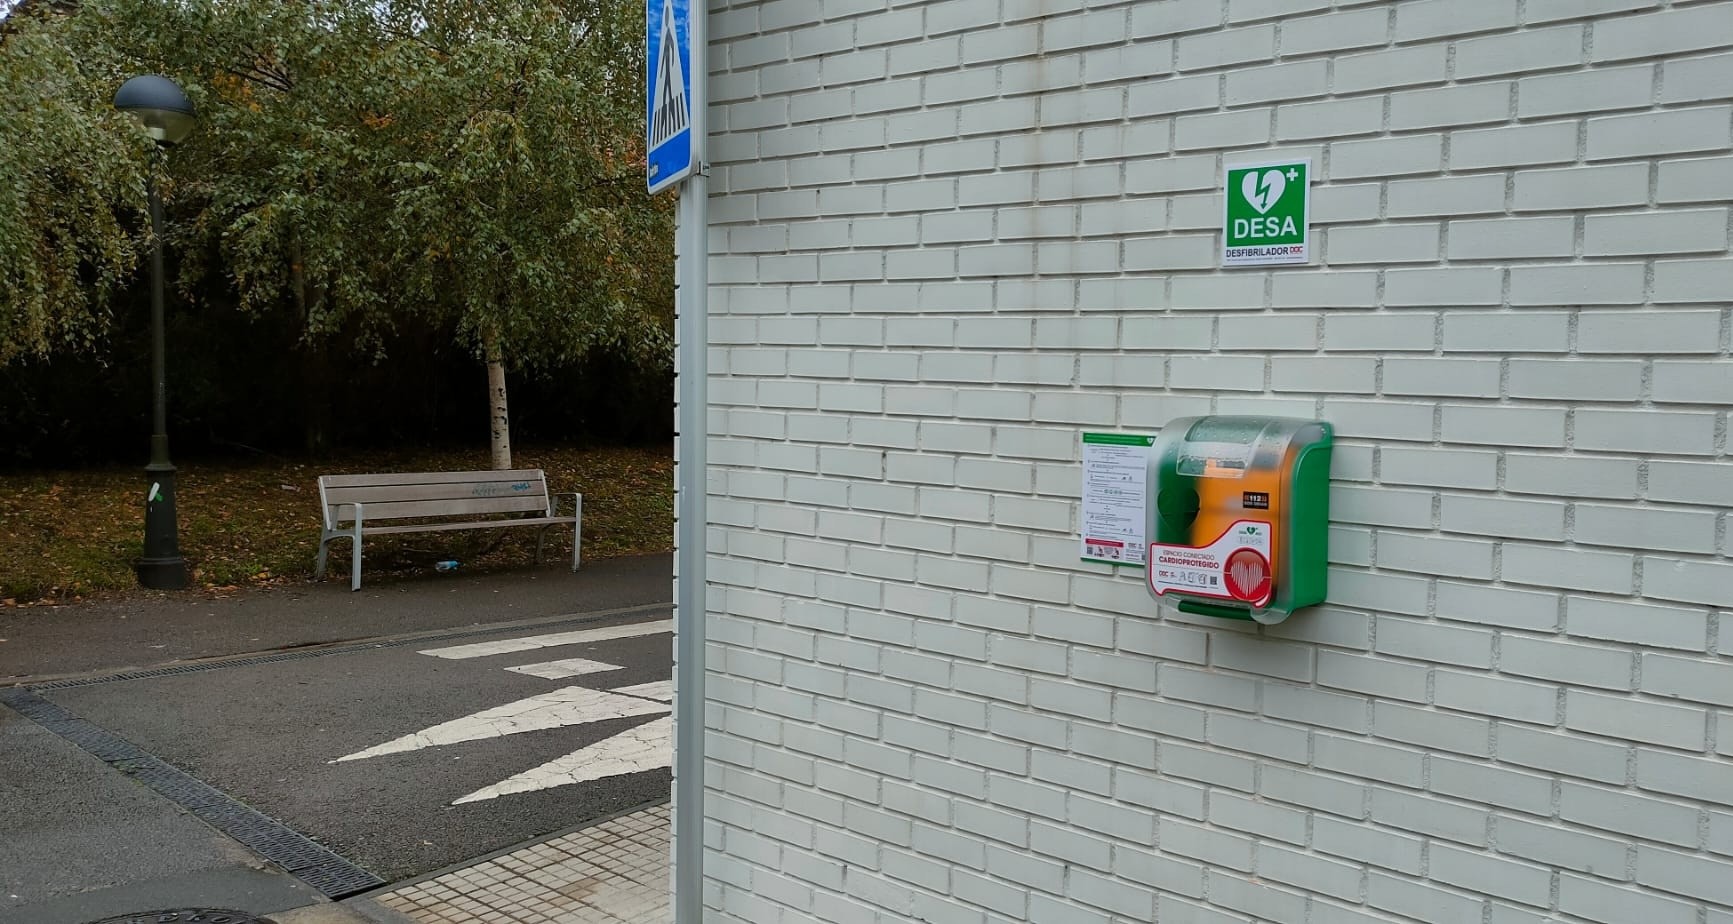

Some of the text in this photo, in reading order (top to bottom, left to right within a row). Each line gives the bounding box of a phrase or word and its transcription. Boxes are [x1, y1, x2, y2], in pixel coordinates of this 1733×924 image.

[1234, 215, 1297, 239] DESA
[1226, 247, 1289, 257] DESFIBRILADOR
[1158, 555, 1220, 569] CARDIOPROTEGIDO
